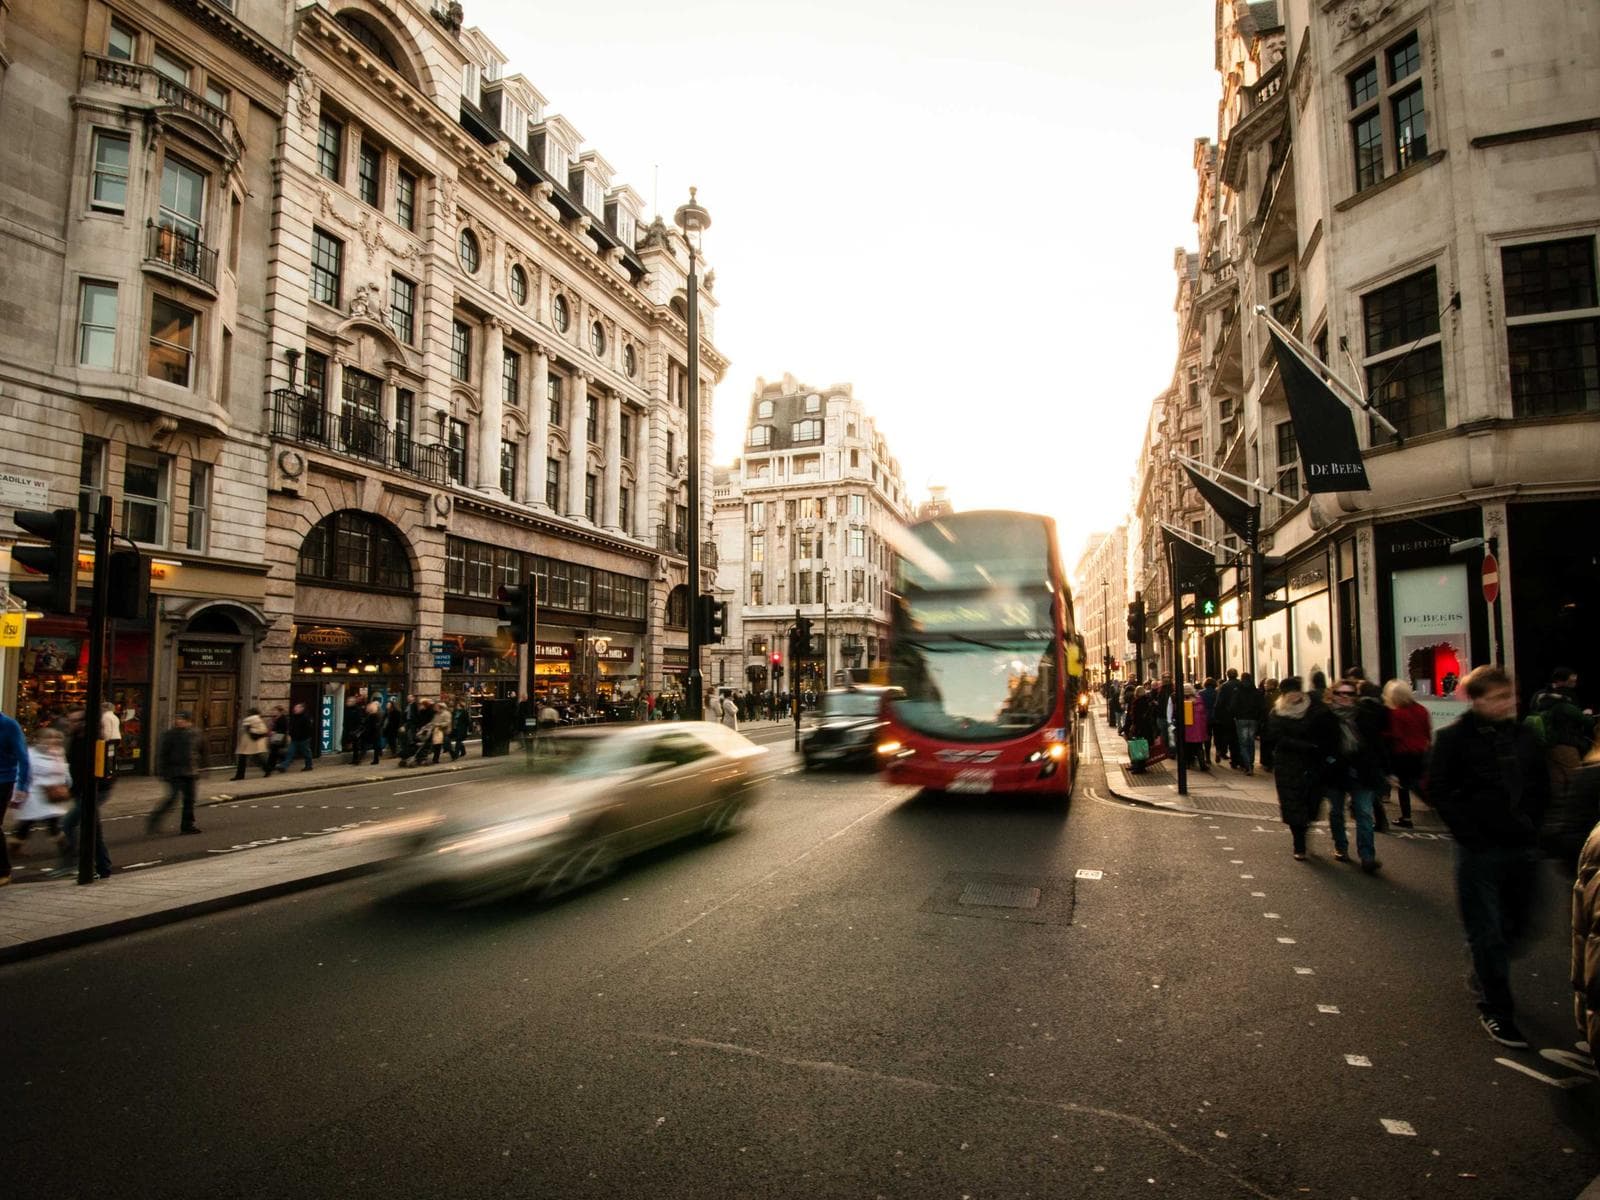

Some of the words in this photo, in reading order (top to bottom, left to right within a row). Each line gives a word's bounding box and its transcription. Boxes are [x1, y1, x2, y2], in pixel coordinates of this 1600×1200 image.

[1310, 464, 1329, 476] DE
[1391, 543, 1412, 553] DE
[3, 622, 18, 635] itsu
[322, 696, 331, 750] MONEY
